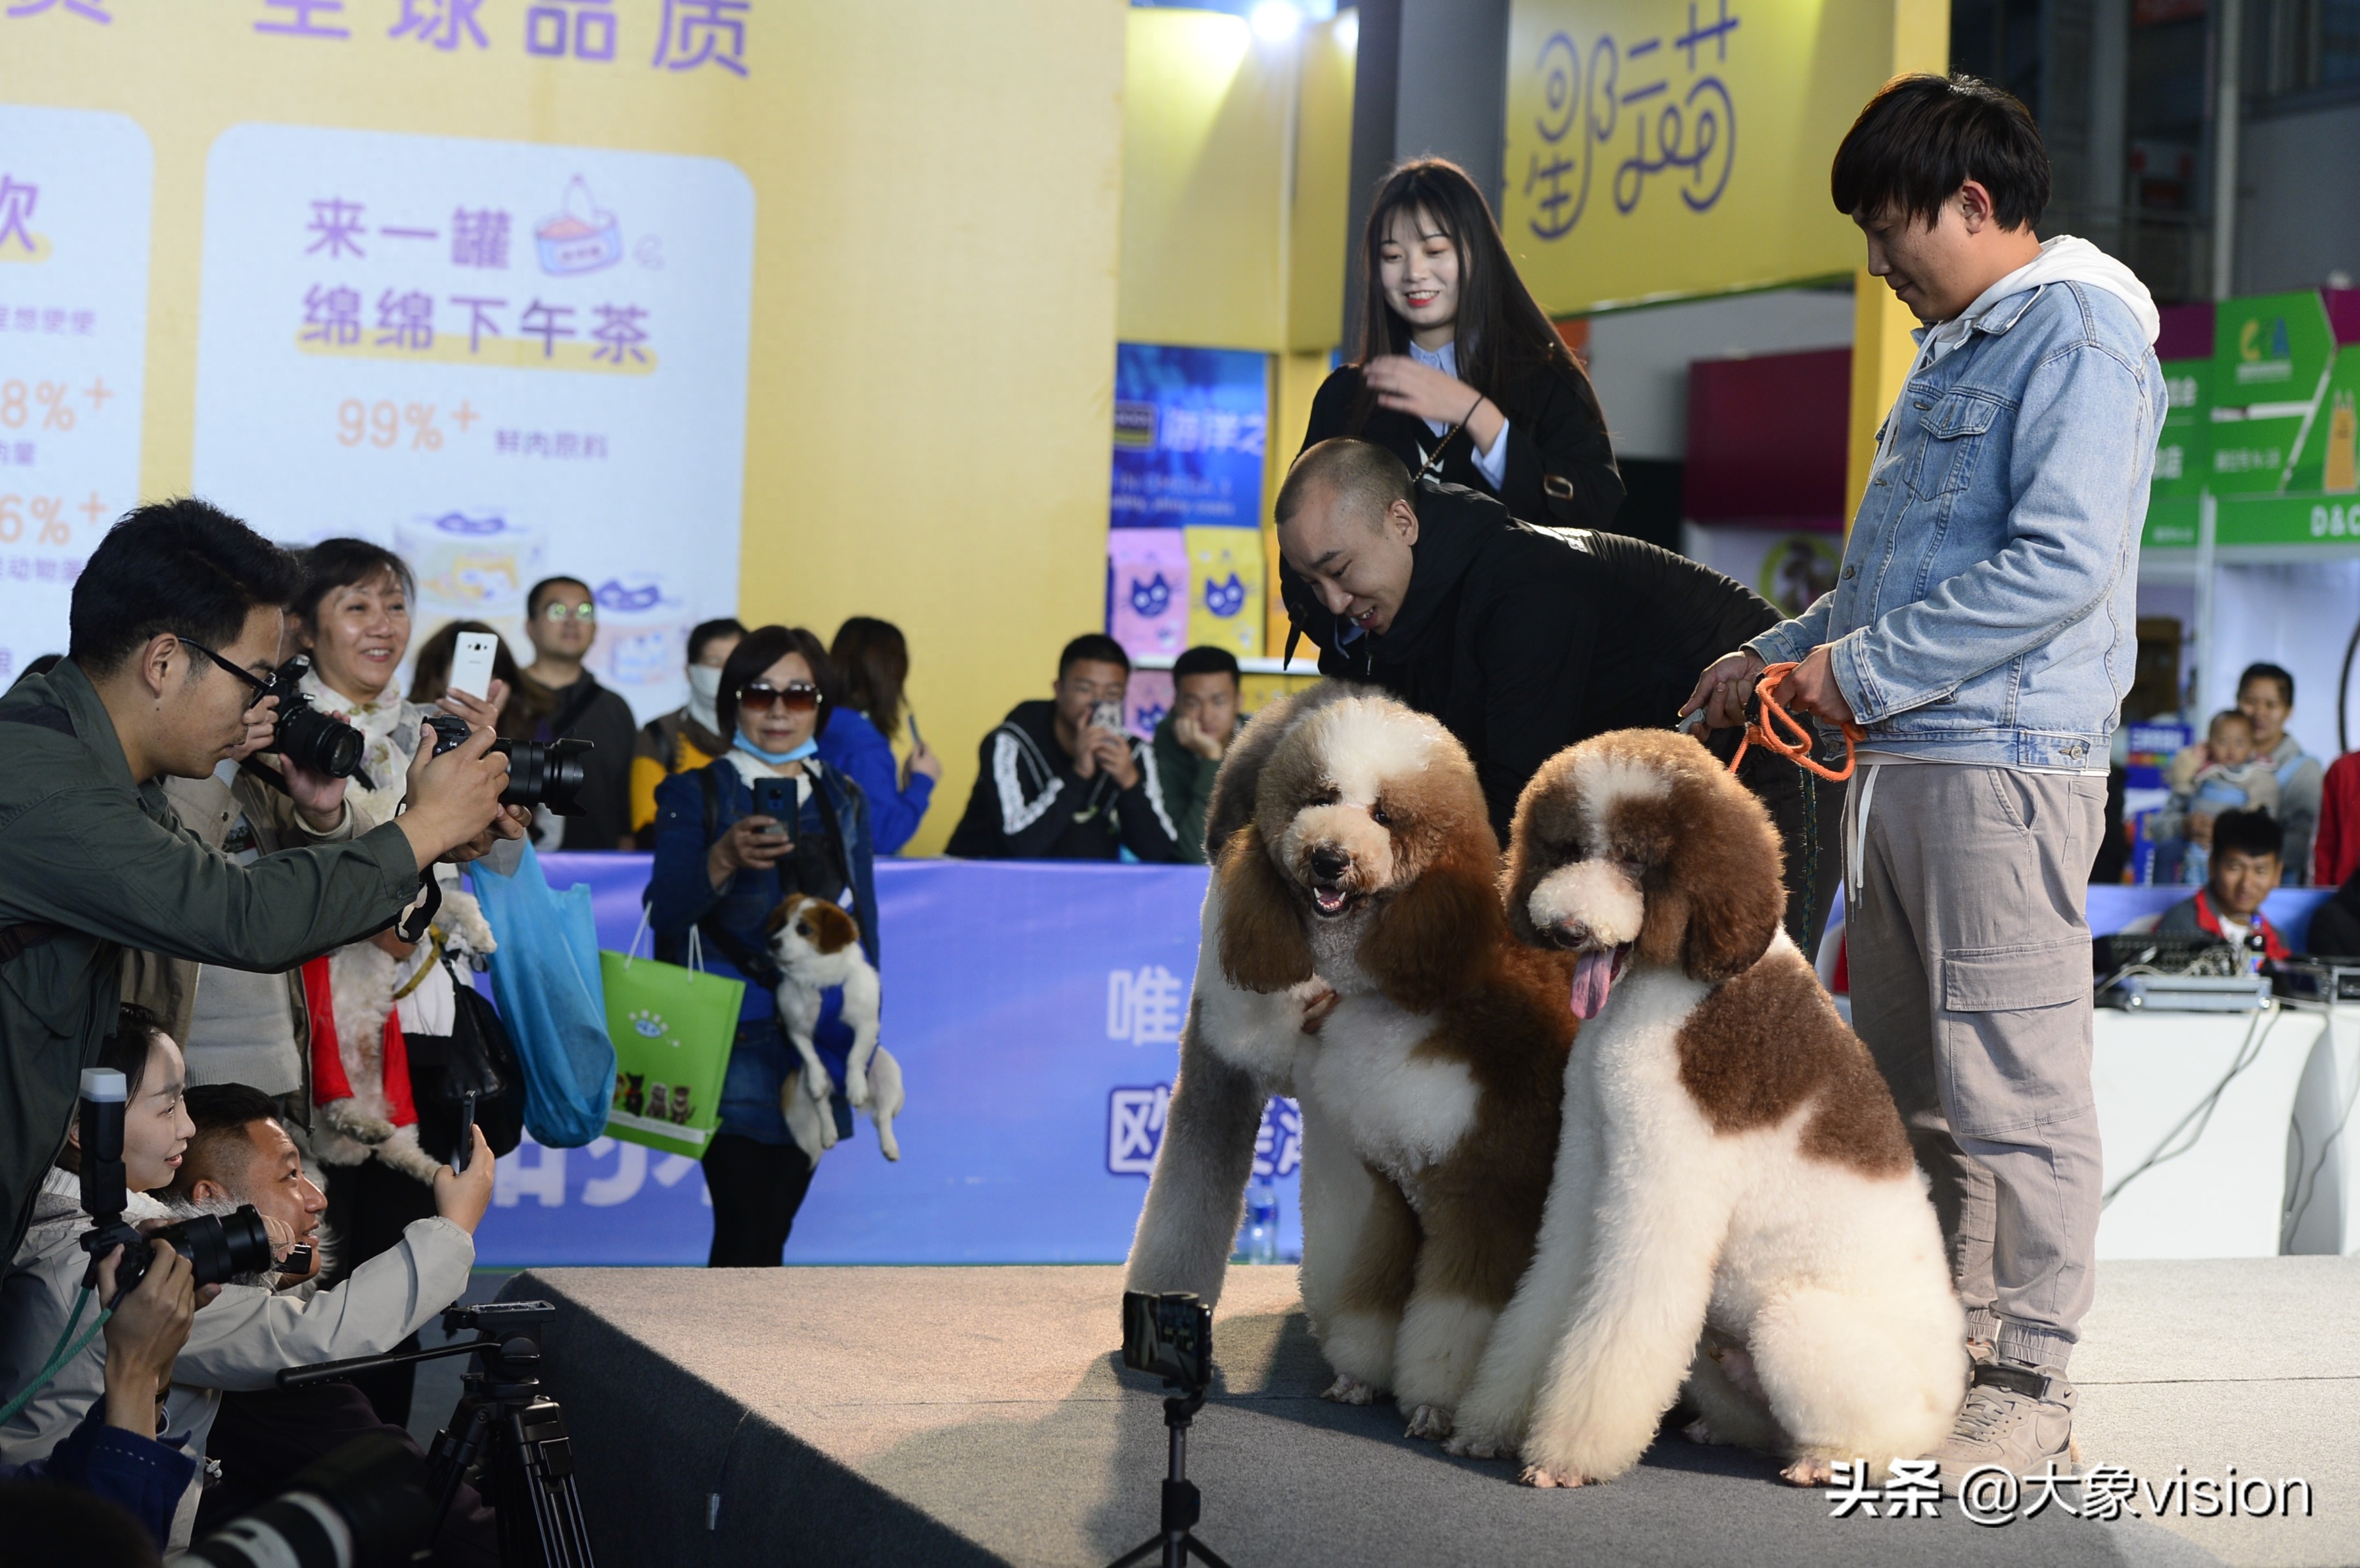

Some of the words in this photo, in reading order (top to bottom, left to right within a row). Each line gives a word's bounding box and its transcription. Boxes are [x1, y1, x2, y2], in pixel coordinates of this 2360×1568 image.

[305, 197, 511, 270] 来一罐
[300, 282, 651, 365] 绵绵下午茶
